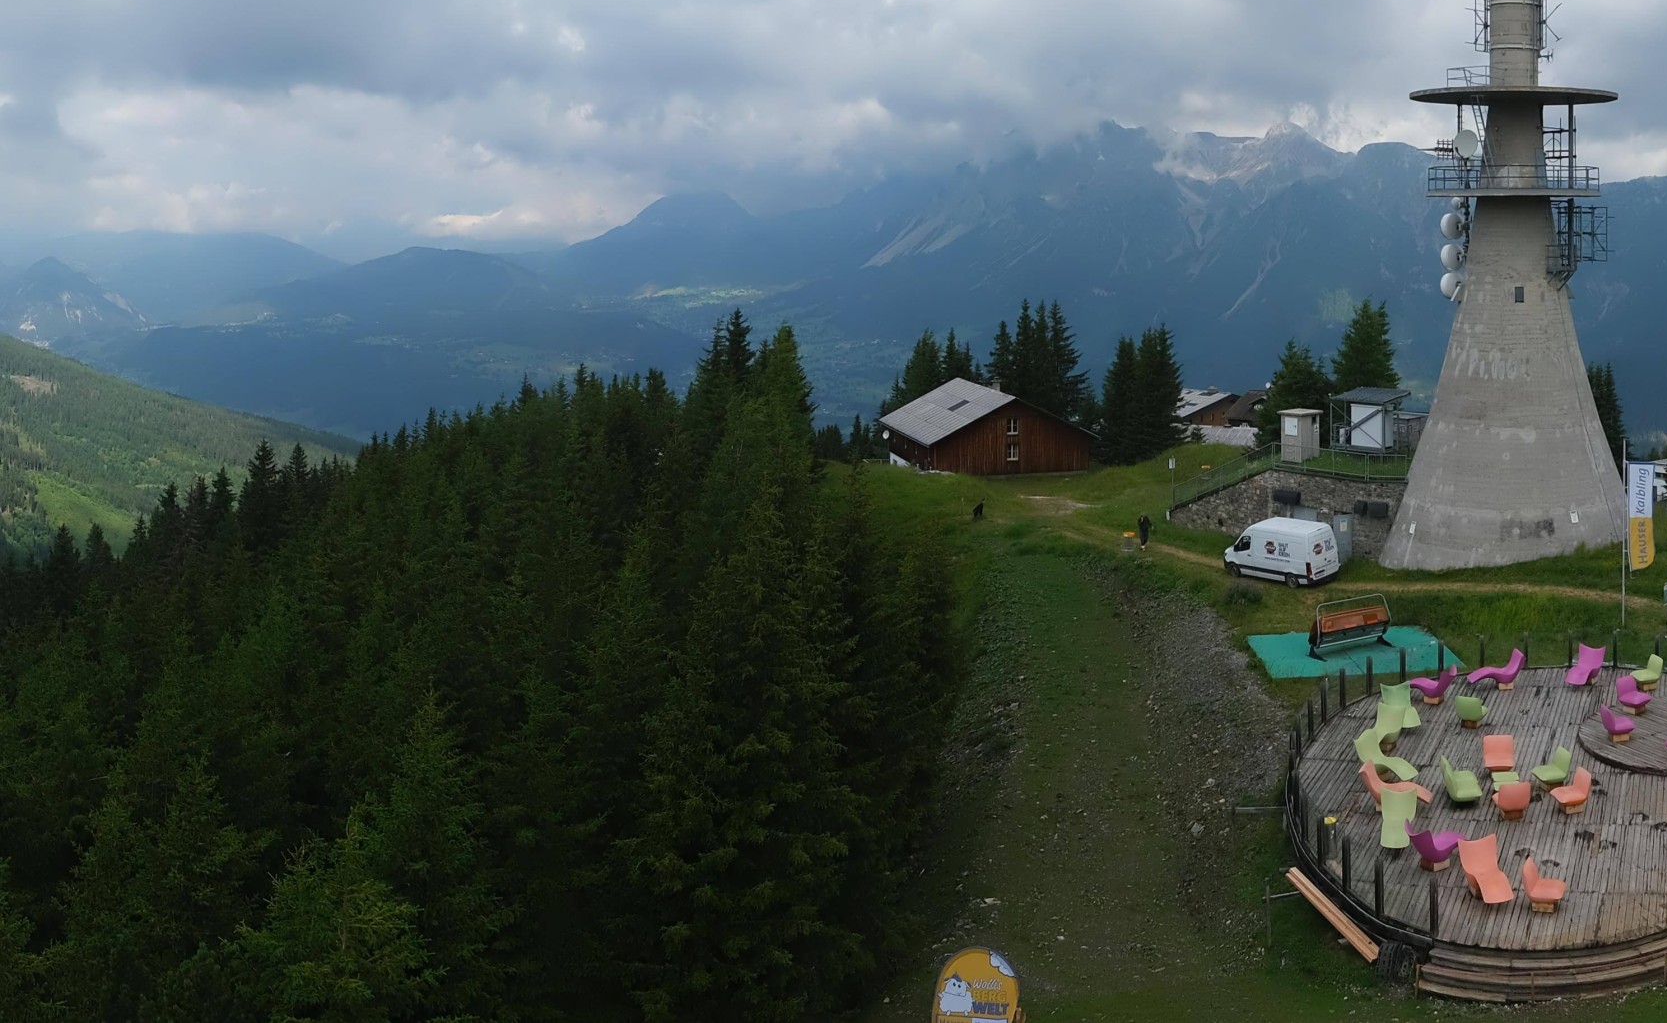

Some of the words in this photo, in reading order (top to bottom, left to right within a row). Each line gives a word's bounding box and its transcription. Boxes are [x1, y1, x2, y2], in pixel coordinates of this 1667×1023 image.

[1635, 467, 1650, 515] Kaibling
[1637, 520, 1648, 565] HAUSER
[972, 991, 1007, 1003] BERG
[972, 1002, 1009, 1015] WELT
